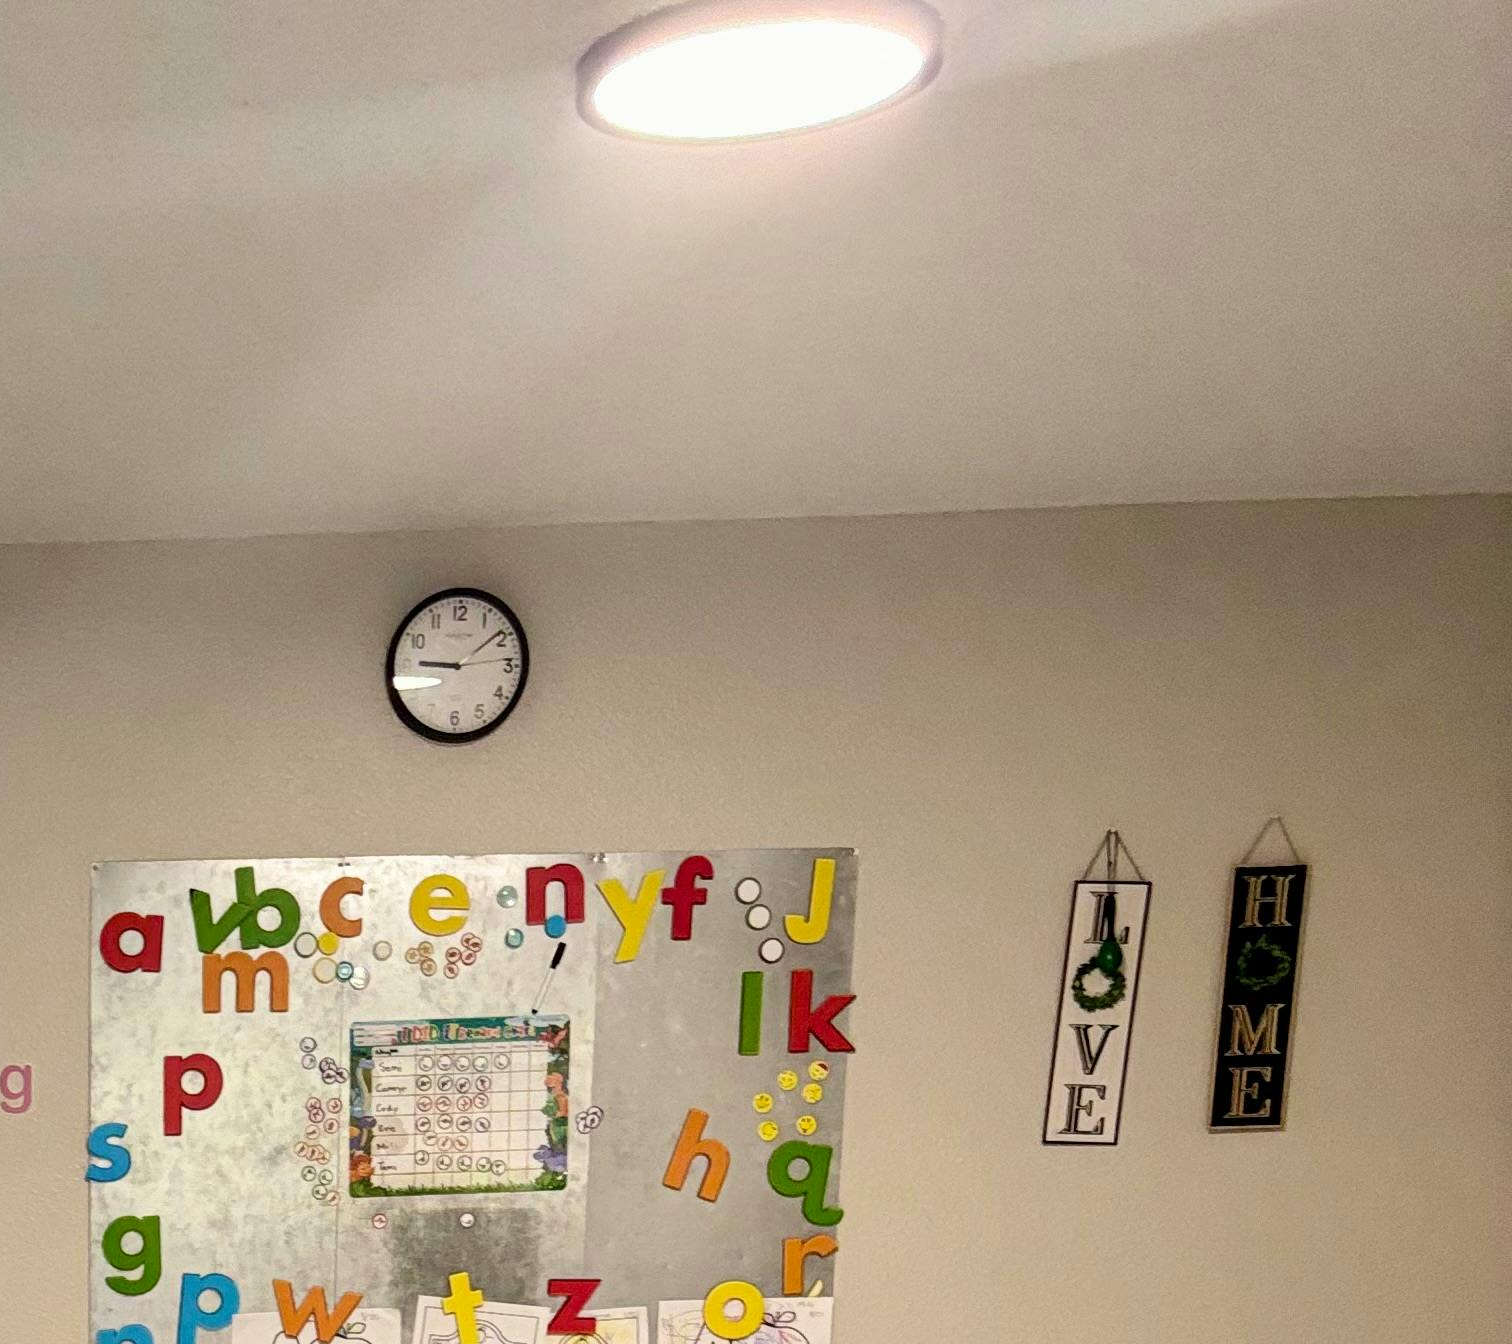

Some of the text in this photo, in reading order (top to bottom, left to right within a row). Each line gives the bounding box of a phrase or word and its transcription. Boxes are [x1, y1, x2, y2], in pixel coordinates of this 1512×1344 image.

[411, 633, 426, 649] 10
[431, 613, 441, 629] 11
[453, 605, 468, 622] 12
[482, 612, 487, 628] 1
[496, 631, 506, 648] 2
[494, 685, 503, 700] 4
[503, 658, 513, 673] 3
[450, 711, 460, 726] 6
[474, 704, 485, 719] 5
[190, 888, 253, 953] v
[235, 866, 300, 950] b
[319, 876, 364, 937] c
[409, 874, 470, 936] e
[526, 863, 585, 926] n
[595, 868, 665, 964] y
[661, 855, 714, 941] f
[99, 911, 164, 973] a
[202, 951, 289, 1013] m
[788, 968, 857, 1053] k
[0, 1063, 32, 1114] g
[163, 1053, 223, 1136] p
[84, 1122, 131, 1183] s
[662, 1107, 731, 1203] h
[766, 1140, 844, 1227] q
[101, 1215, 161, 1296] g
[782, 1233, 837, 1296] r
[272, 1279, 364, 1344] w
[546, 1278, 602, 1335] z
[704, 1280, 765, 1340] o
